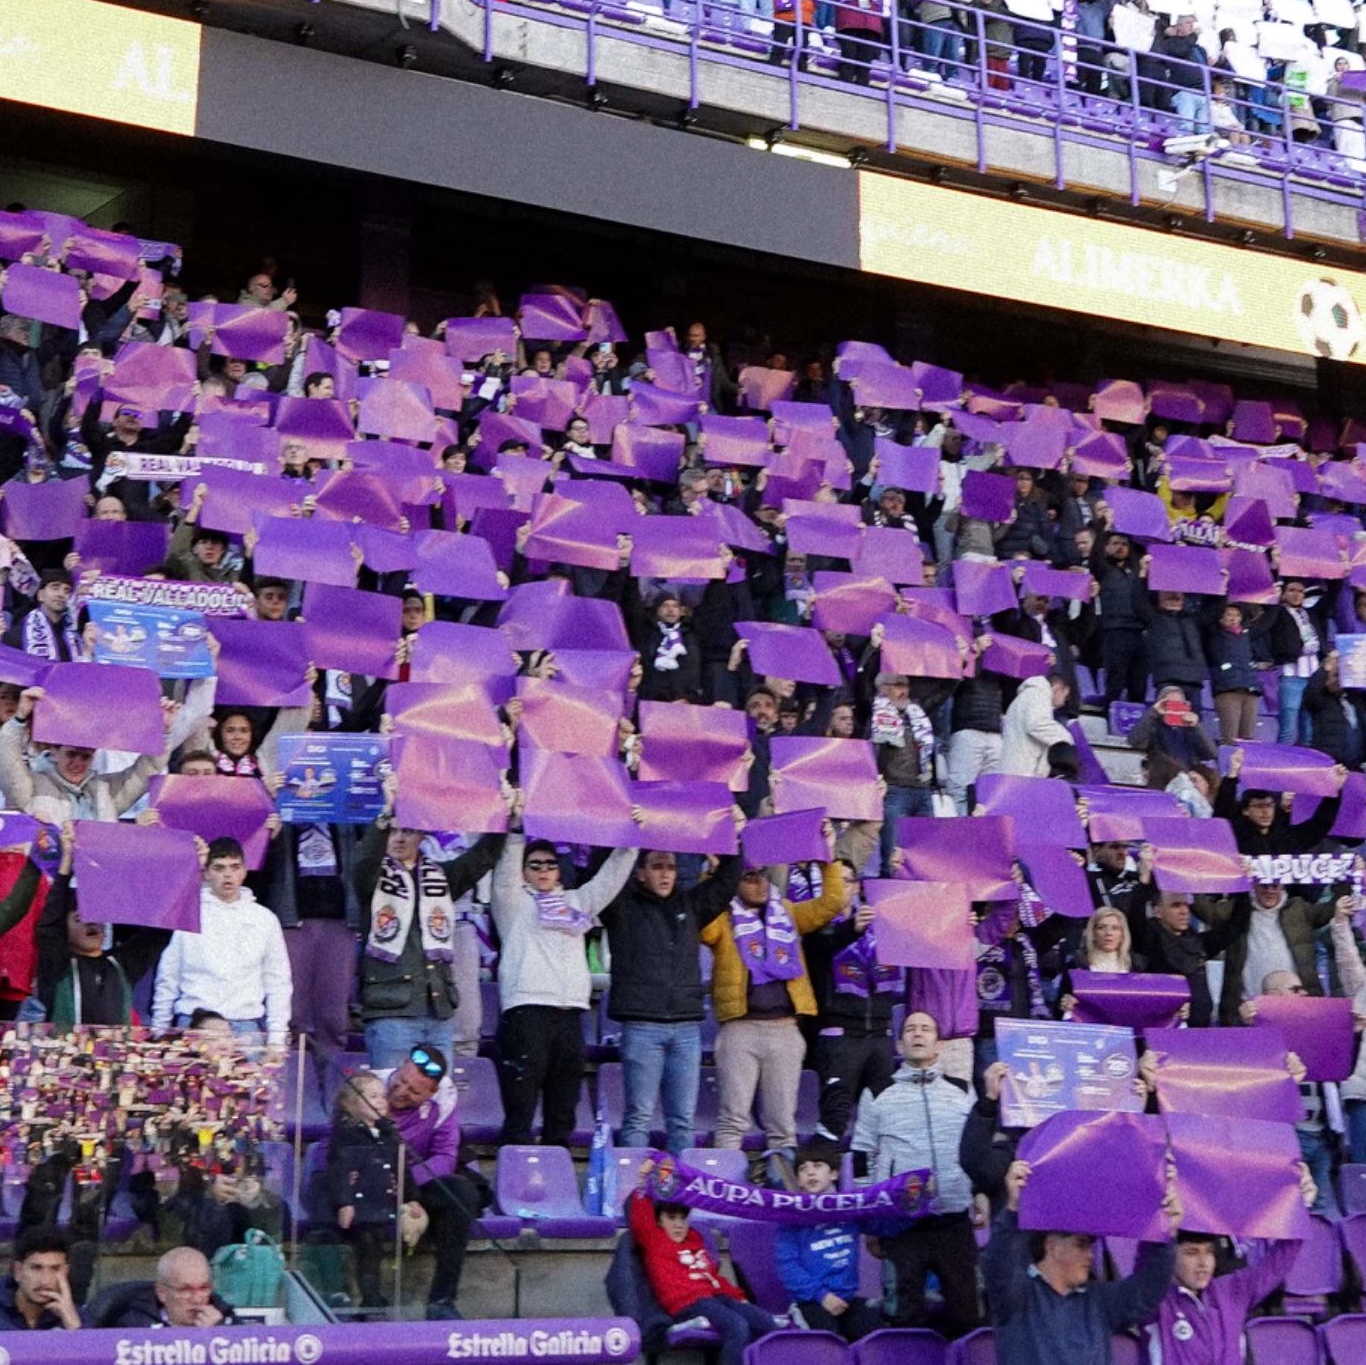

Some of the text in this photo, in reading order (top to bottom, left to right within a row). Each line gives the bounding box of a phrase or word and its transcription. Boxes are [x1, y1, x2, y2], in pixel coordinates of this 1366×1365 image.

[1031, 236, 1246, 317] ALIMERKA
[91, 582, 138, 600] REAL
[685, 1173, 894, 1213] AÚPA PUCELA
[115, 1334, 291, 1365] Estrella Galicia
[447, 1329, 602, 1358] Estrella Galicia
